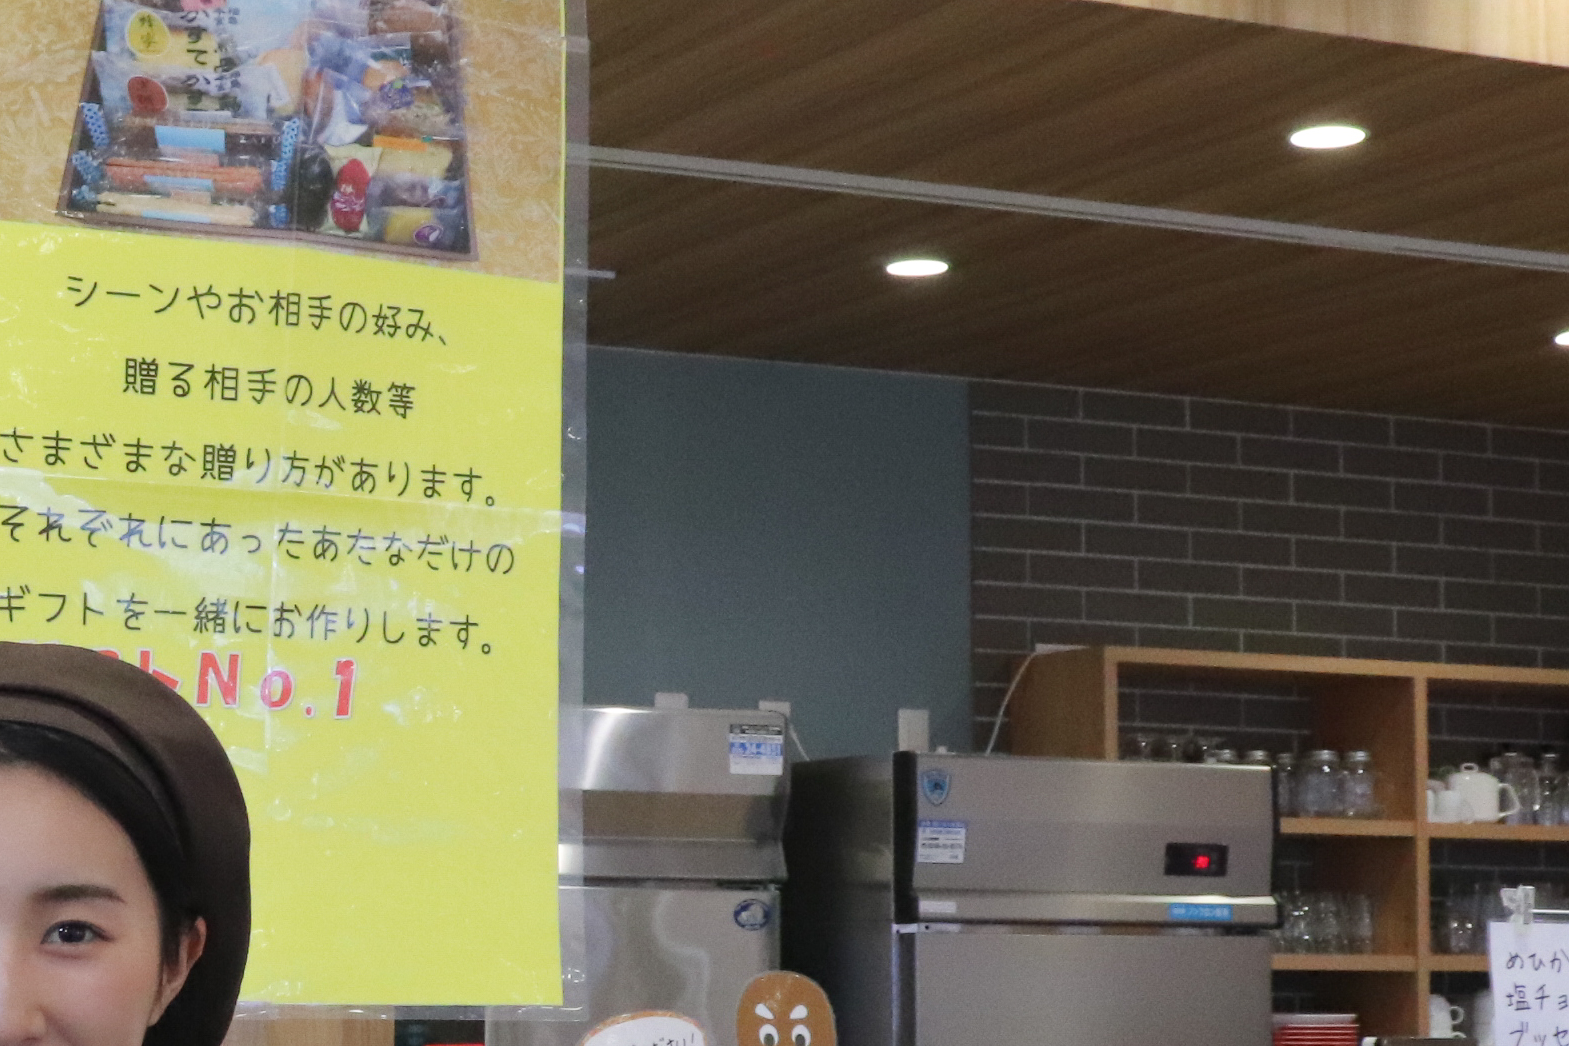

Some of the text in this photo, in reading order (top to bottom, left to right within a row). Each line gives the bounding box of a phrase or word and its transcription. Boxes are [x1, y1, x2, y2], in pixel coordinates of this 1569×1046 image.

[66, 274, 449, 347] シーンやお相手の好み、
[122, 358, 416, 419] 贈る相手の人数等
